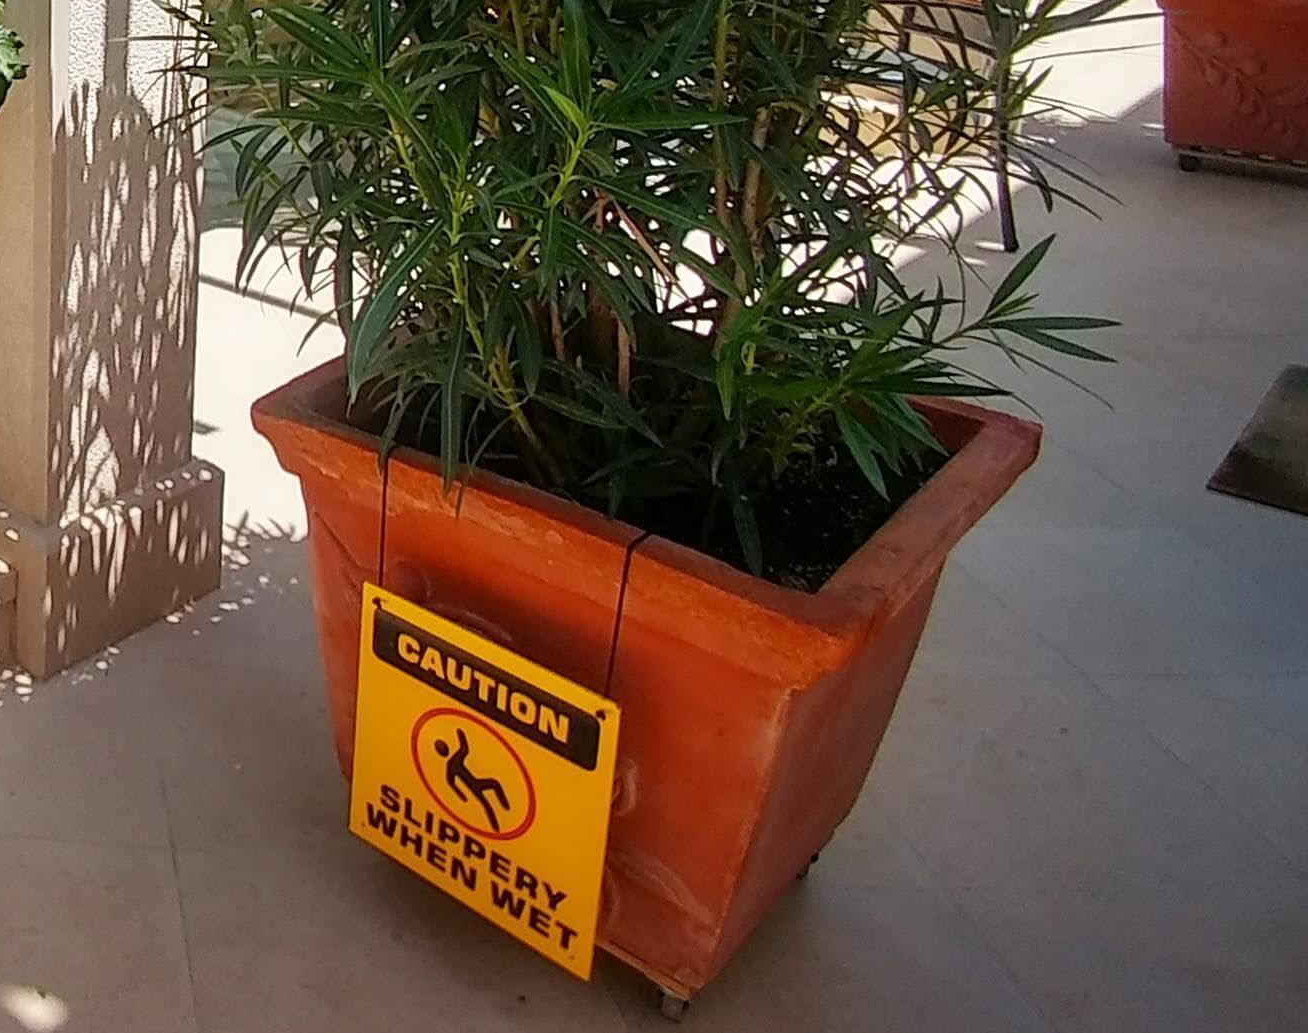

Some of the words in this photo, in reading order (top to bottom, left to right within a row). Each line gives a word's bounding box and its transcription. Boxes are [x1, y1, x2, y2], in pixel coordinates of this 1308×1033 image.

[397, 633, 569, 743] CAUTION
[366, 802, 477, 891] WHEN
[491, 880, 578, 950] WET
[380, 784, 568, 911] SLIPPERY
